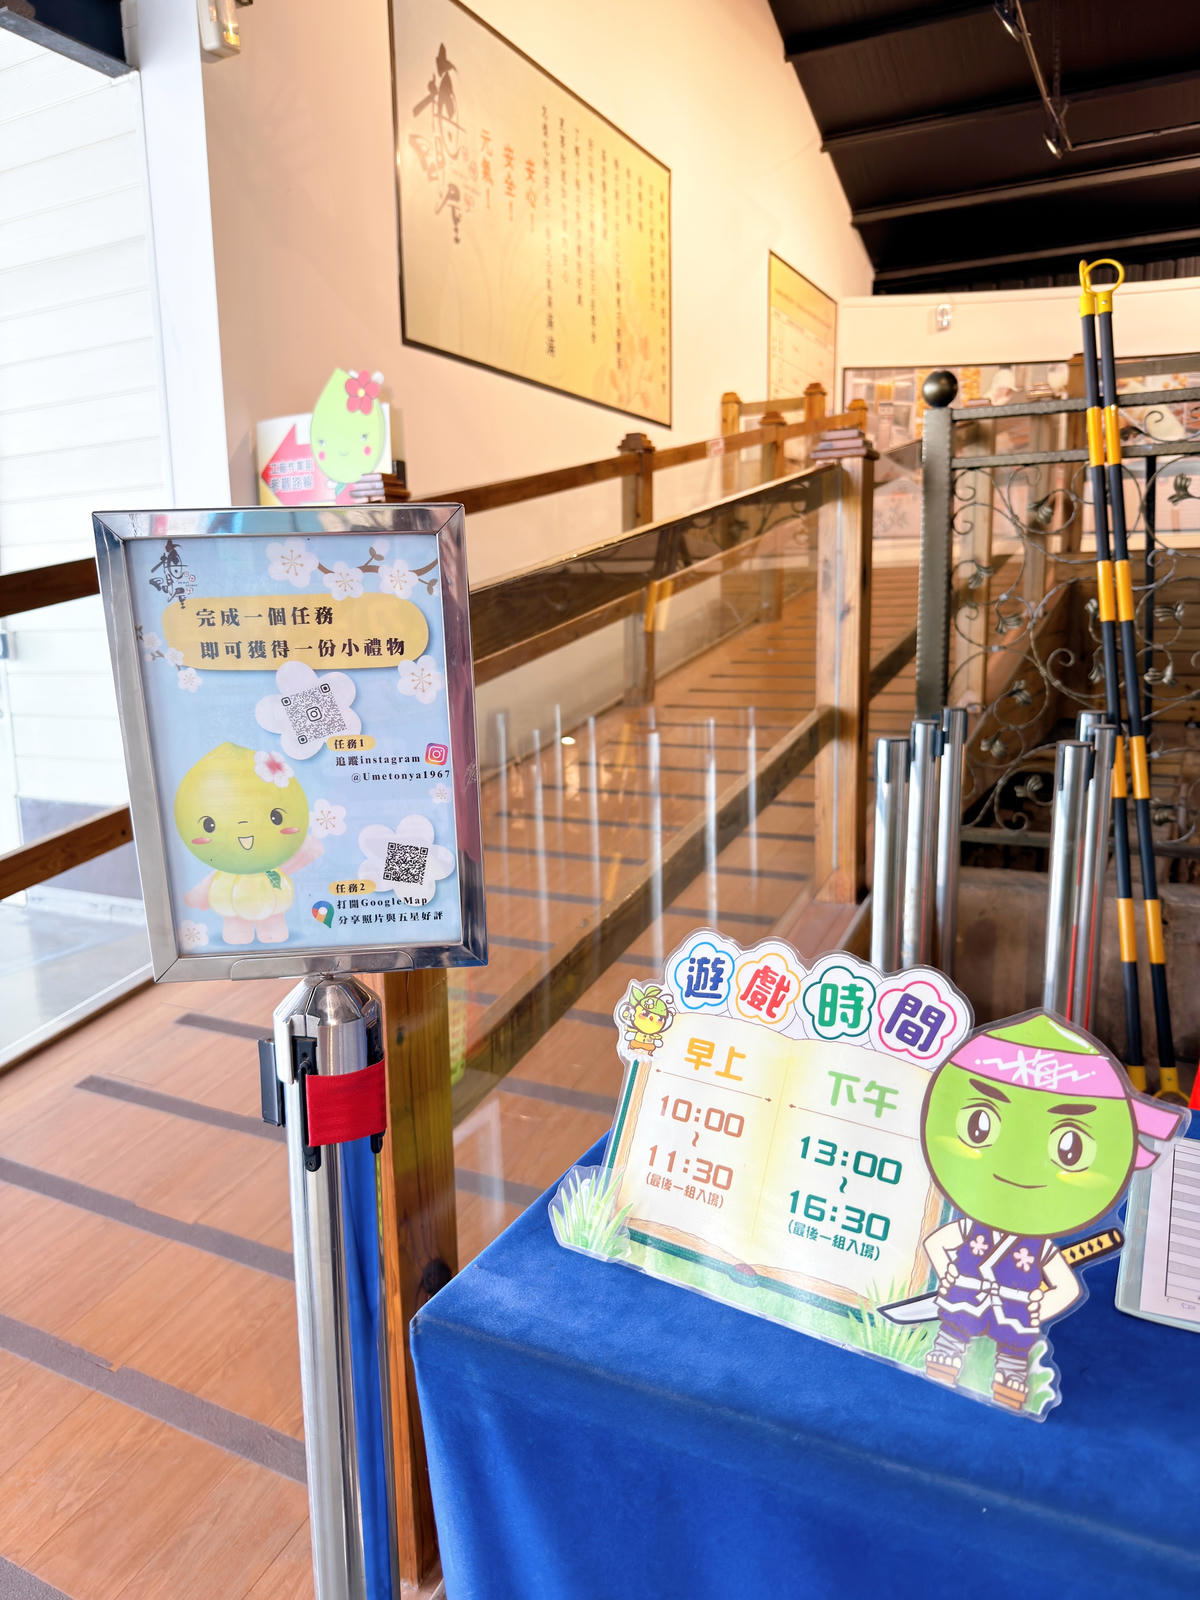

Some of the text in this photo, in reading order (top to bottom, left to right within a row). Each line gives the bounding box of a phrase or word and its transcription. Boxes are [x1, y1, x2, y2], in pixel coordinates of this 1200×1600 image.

[196, 606, 334, 627] 完成一個任務
[200, 637, 405, 660] 即可獲得一份小禮物
[334, 739, 365, 750] 任務1
[351, 770, 450, 783] @Umetonya1967
[336, 883, 366, 893] 任務2
[338, 911, 443, 925] 分享照片與五星好評
[684, 1037, 747, 1082] 早上
[827, 1070, 900, 1119] 下午
[660, 1095, 746, 1139] 10:00
[648, 1145, 734, 1192] 11:30
[800, 1136, 903, 1186] 13:00
[789, 1190, 891, 1242] 16:30
